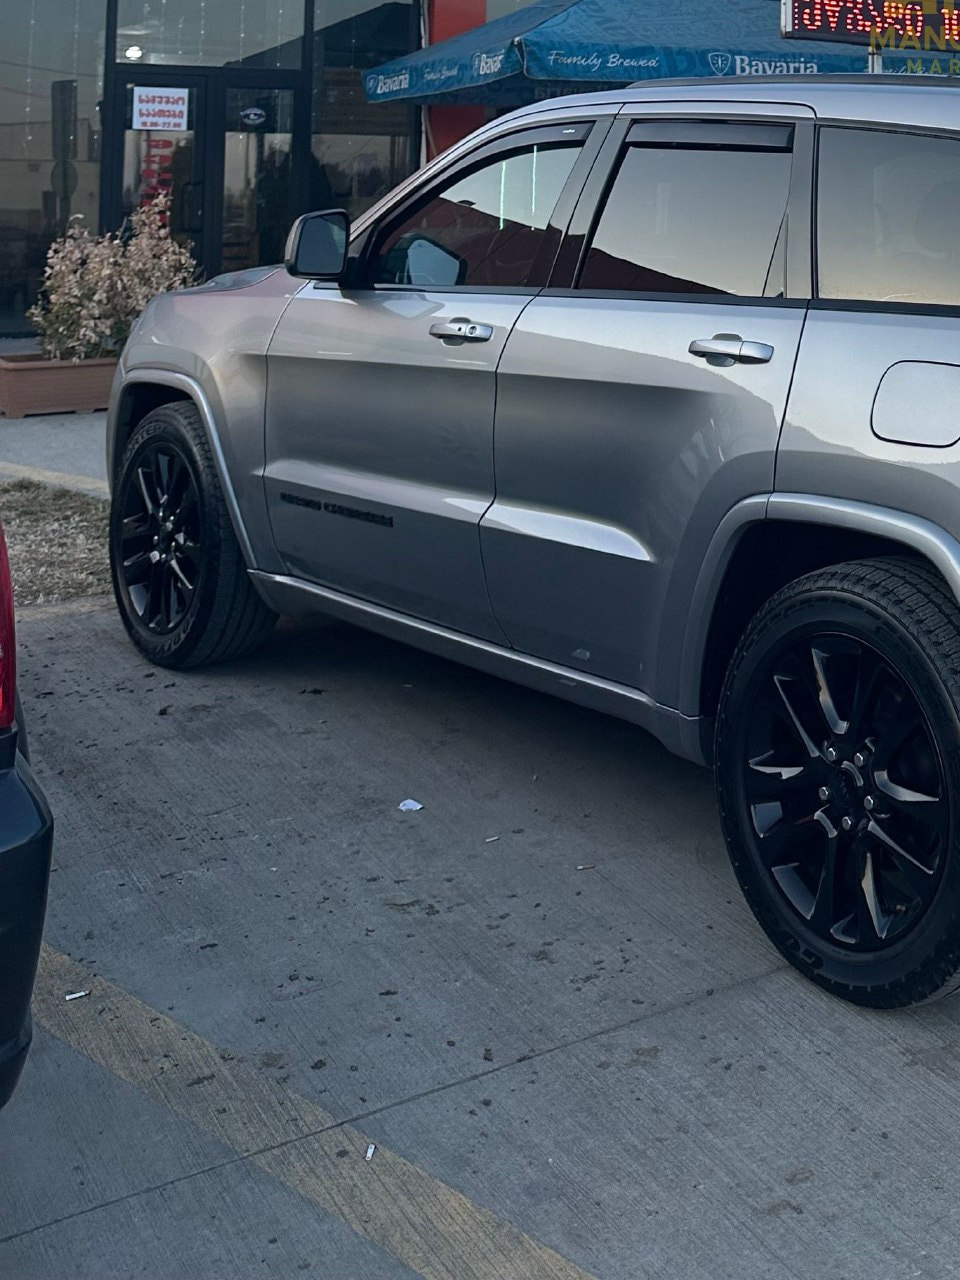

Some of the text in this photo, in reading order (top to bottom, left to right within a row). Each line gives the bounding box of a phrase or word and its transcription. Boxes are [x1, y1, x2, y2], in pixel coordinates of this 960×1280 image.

[548, 50, 659, 71] Family Brewed
[735, 55, 818, 76] Bavaria
[376, 71, 409, 94] Bavaria
